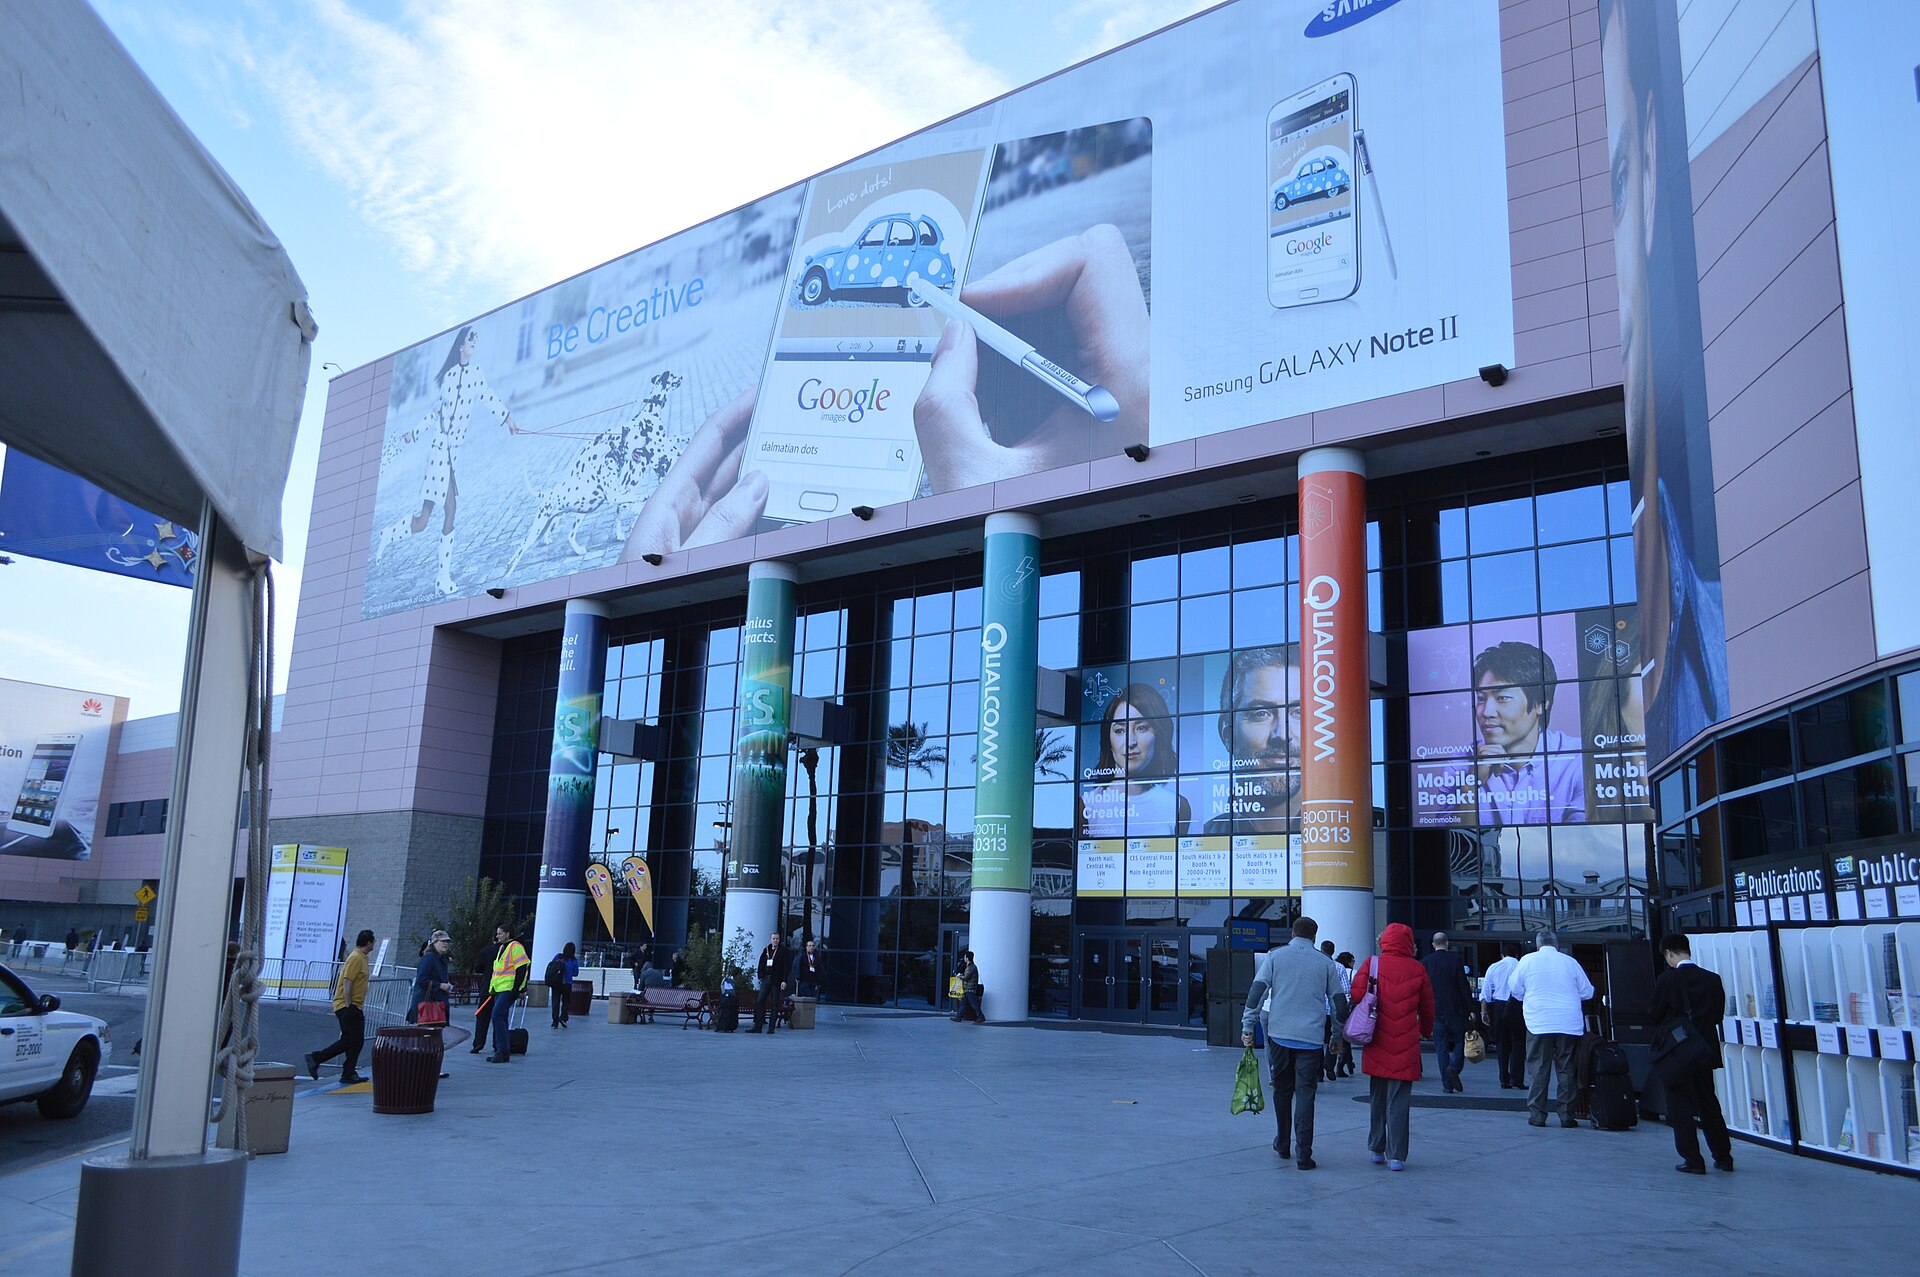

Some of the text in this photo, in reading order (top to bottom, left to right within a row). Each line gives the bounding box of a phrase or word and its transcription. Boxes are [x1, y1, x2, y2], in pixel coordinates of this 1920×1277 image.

[827, 167, 892, 214] Love dots!
[1286, 231, 1332, 255] Google
[547, 278, 704, 360] Be Creative
[1184, 314, 1459, 402] Samsung GALAXY Note II
[1040, 359, 1079, 385] SAMSUNG
[797, 378, 891, 423] Google
[820, 412, 846, 423] images
[761, 441, 818, 455] dalmatian dots
[1304, 575, 1341, 762] QUALCOMM
[981, 622, 1008, 783] QUALCOMM
[1416, 744, 1473, 759] QUALCOMM
[1212, 758, 1260, 771] QUALCOMM
[1084, 767, 1126, 780] QUALCOMM
[1417, 770, 1482, 788] Mobile.
[1083, 791, 1130, 804] Mobile.
[1212, 783, 1267, 798] Mobile.
[1418, 785, 1554, 806] Breakthroughs.
[1596, 784, 1618, 798] to
[1083, 804, 1139, 819] Created.
[1212, 799, 1266, 813] Native.
[1303, 810, 1350, 824] BOOTH
[1419, 815, 1461, 824] #bornmobile
[1302, 826, 1351, 844] 30313
[1142, 869, 1173, 877] Registration
[1836, 862, 1850, 872] CES
[1859, 852, 1920, 886] Public
[1736, 878, 1744, 886] CES
[1748, 866, 1822, 898] Publications
